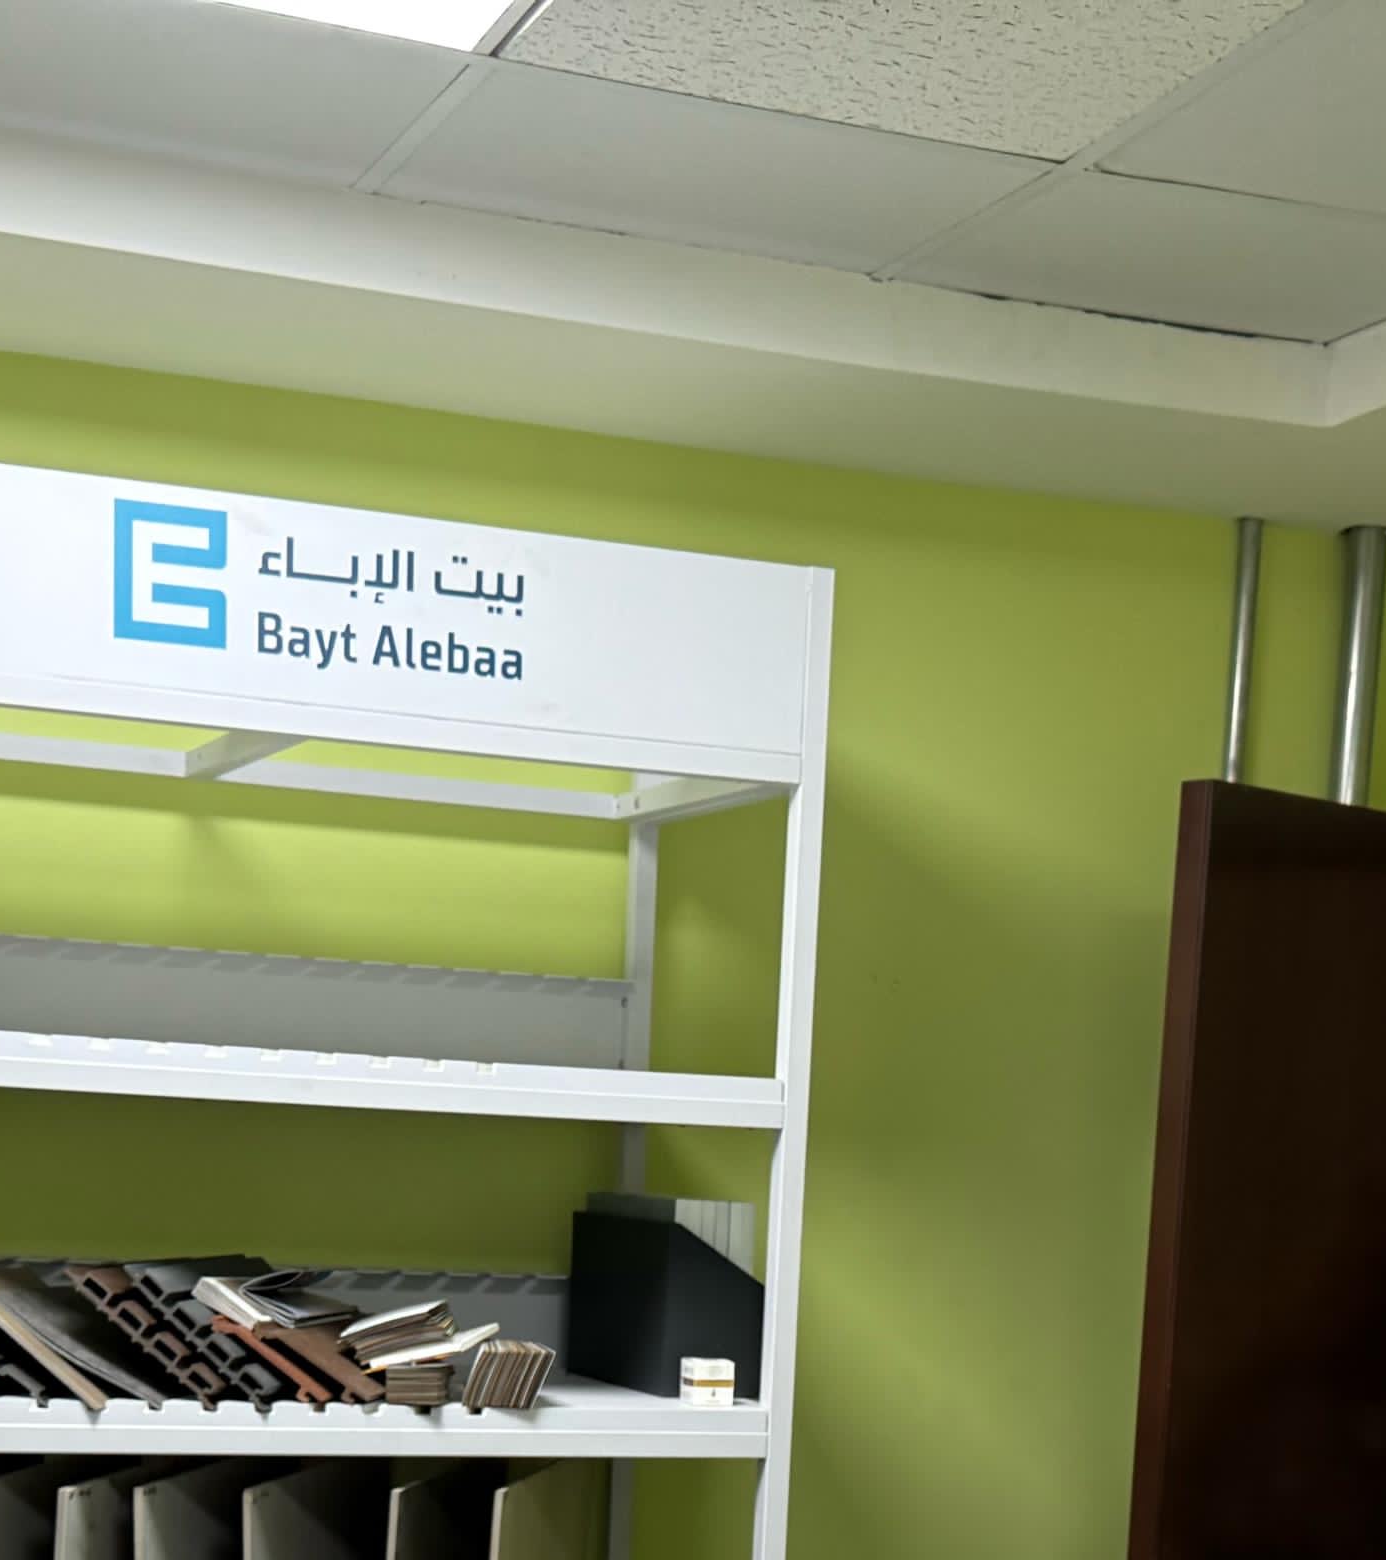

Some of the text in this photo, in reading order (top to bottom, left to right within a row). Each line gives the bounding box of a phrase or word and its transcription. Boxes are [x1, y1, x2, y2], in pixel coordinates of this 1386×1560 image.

[257, 536, 525, 617] بيت الإباء
[256, 611, 524, 682] Bayt Alebaa
